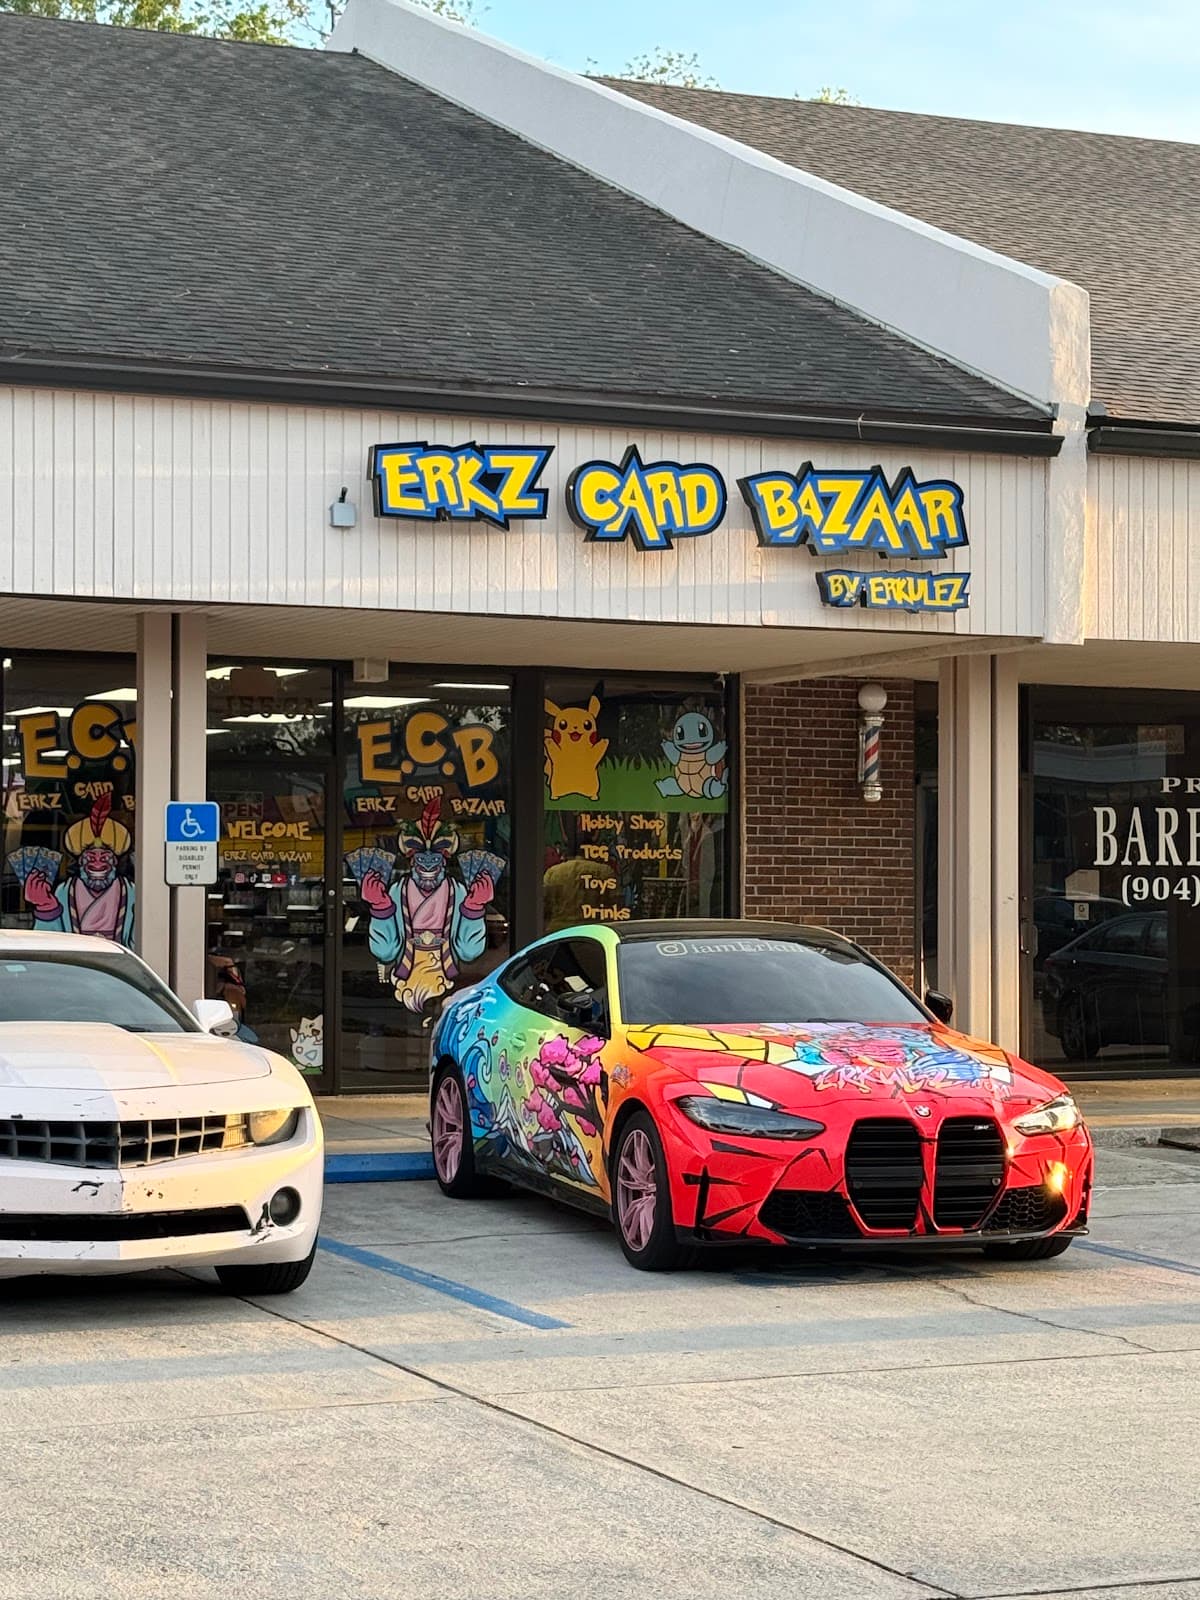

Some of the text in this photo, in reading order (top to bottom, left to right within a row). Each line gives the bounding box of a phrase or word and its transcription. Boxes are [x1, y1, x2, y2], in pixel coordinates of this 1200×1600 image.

[380, 453, 958, 550] ERKZ CARD BAZAAR
[828, 574, 964, 606] BY ERKULEZ
[18, 703, 136, 779] E.C.
[357, 711, 499, 787] E.C.B
[18, 793, 62, 809] ERKZ
[223, 803, 262, 817] PEN
[356, 796, 505, 816] ERKZ BAZAAR
[226, 820, 312, 841] WELCOME
[580, 813, 665, 836] Hobby Shop
[250, 850, 275, 863] CARD
[580, 842, 682, 861] TCG Products
[580, 874, 617, 895] Toys
[1121, 874, 1200, 907] (904)
[581, 903, 632, 921] Drinks
